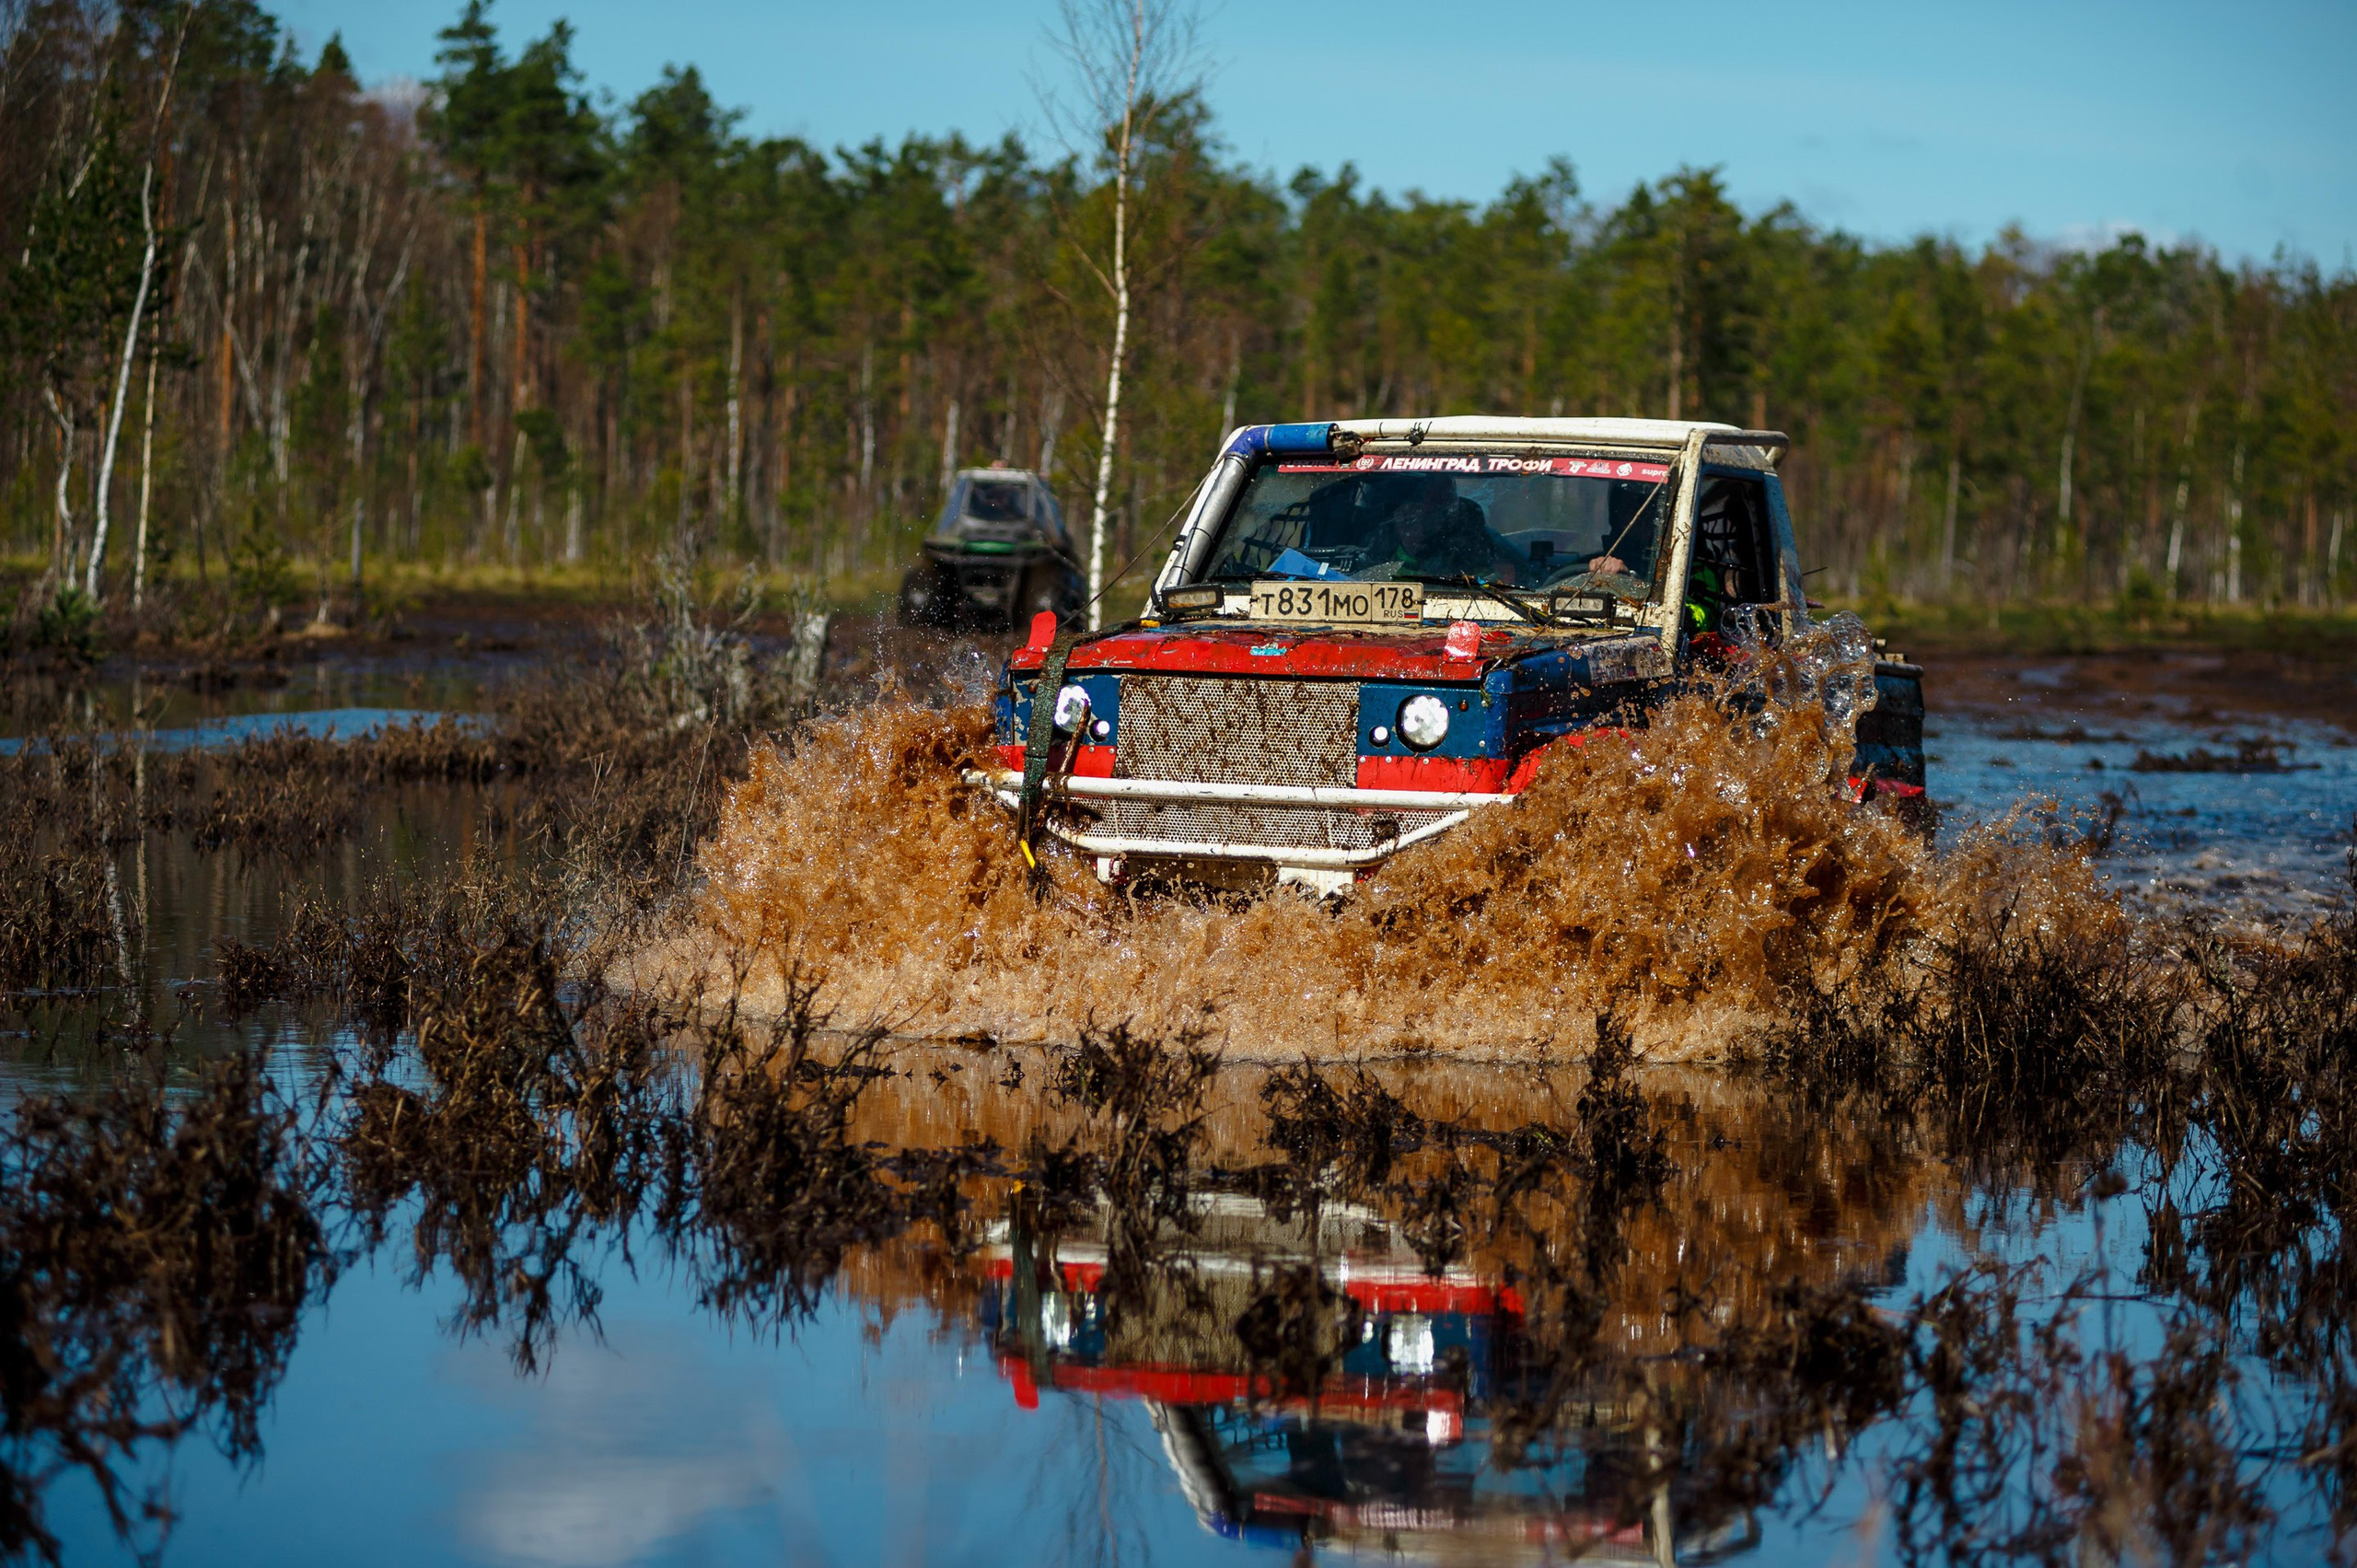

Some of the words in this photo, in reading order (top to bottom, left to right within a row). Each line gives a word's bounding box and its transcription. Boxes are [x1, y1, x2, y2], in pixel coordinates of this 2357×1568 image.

[1380, 458, 1480, 471] ЛЕНИНГРАД
[1487, 458, 1553, 471] ТРОФИ
[1374, 587, 1414, 609] 178
[1383, 610, 1404, 618] RUS
